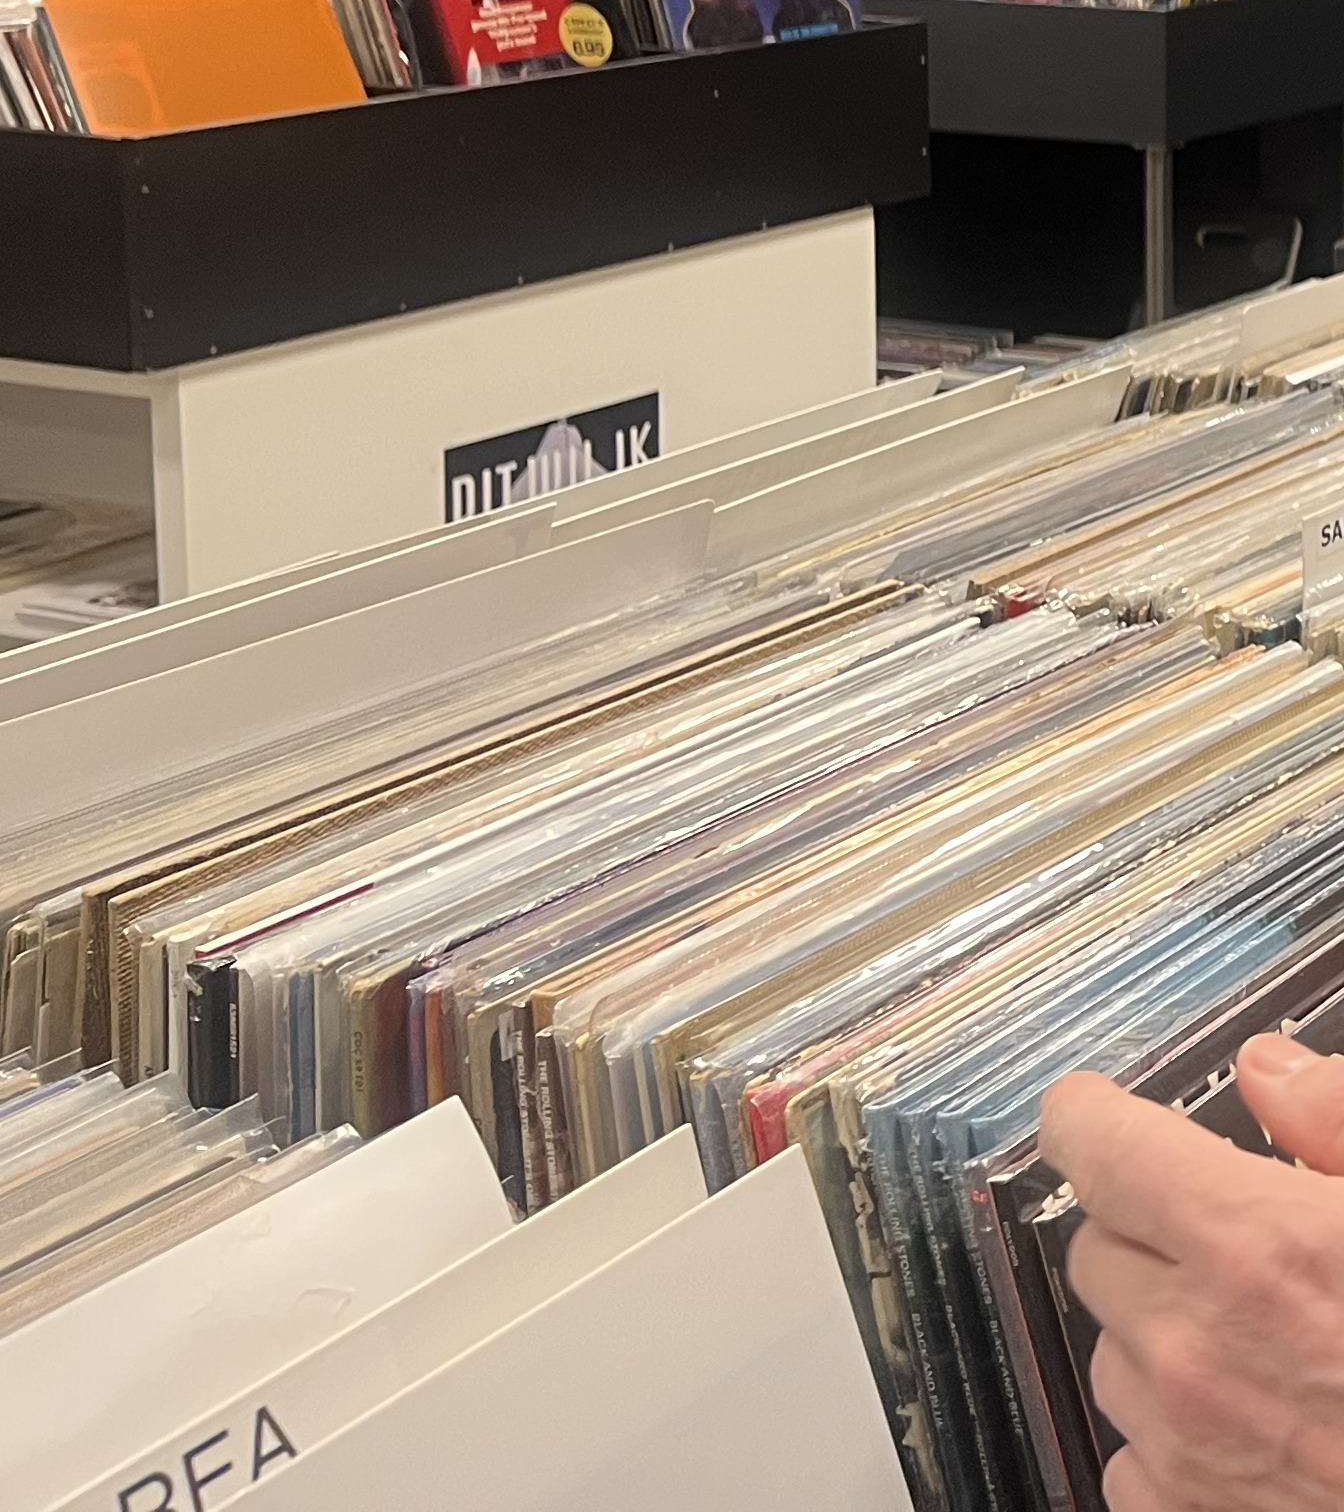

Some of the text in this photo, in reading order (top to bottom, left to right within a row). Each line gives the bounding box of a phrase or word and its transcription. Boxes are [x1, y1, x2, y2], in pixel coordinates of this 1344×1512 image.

[541, 1086, 554, 1140] ROLLING
[895, 1245, 916, 1299] STONES
[923, 1362, 936, 1393] AND
